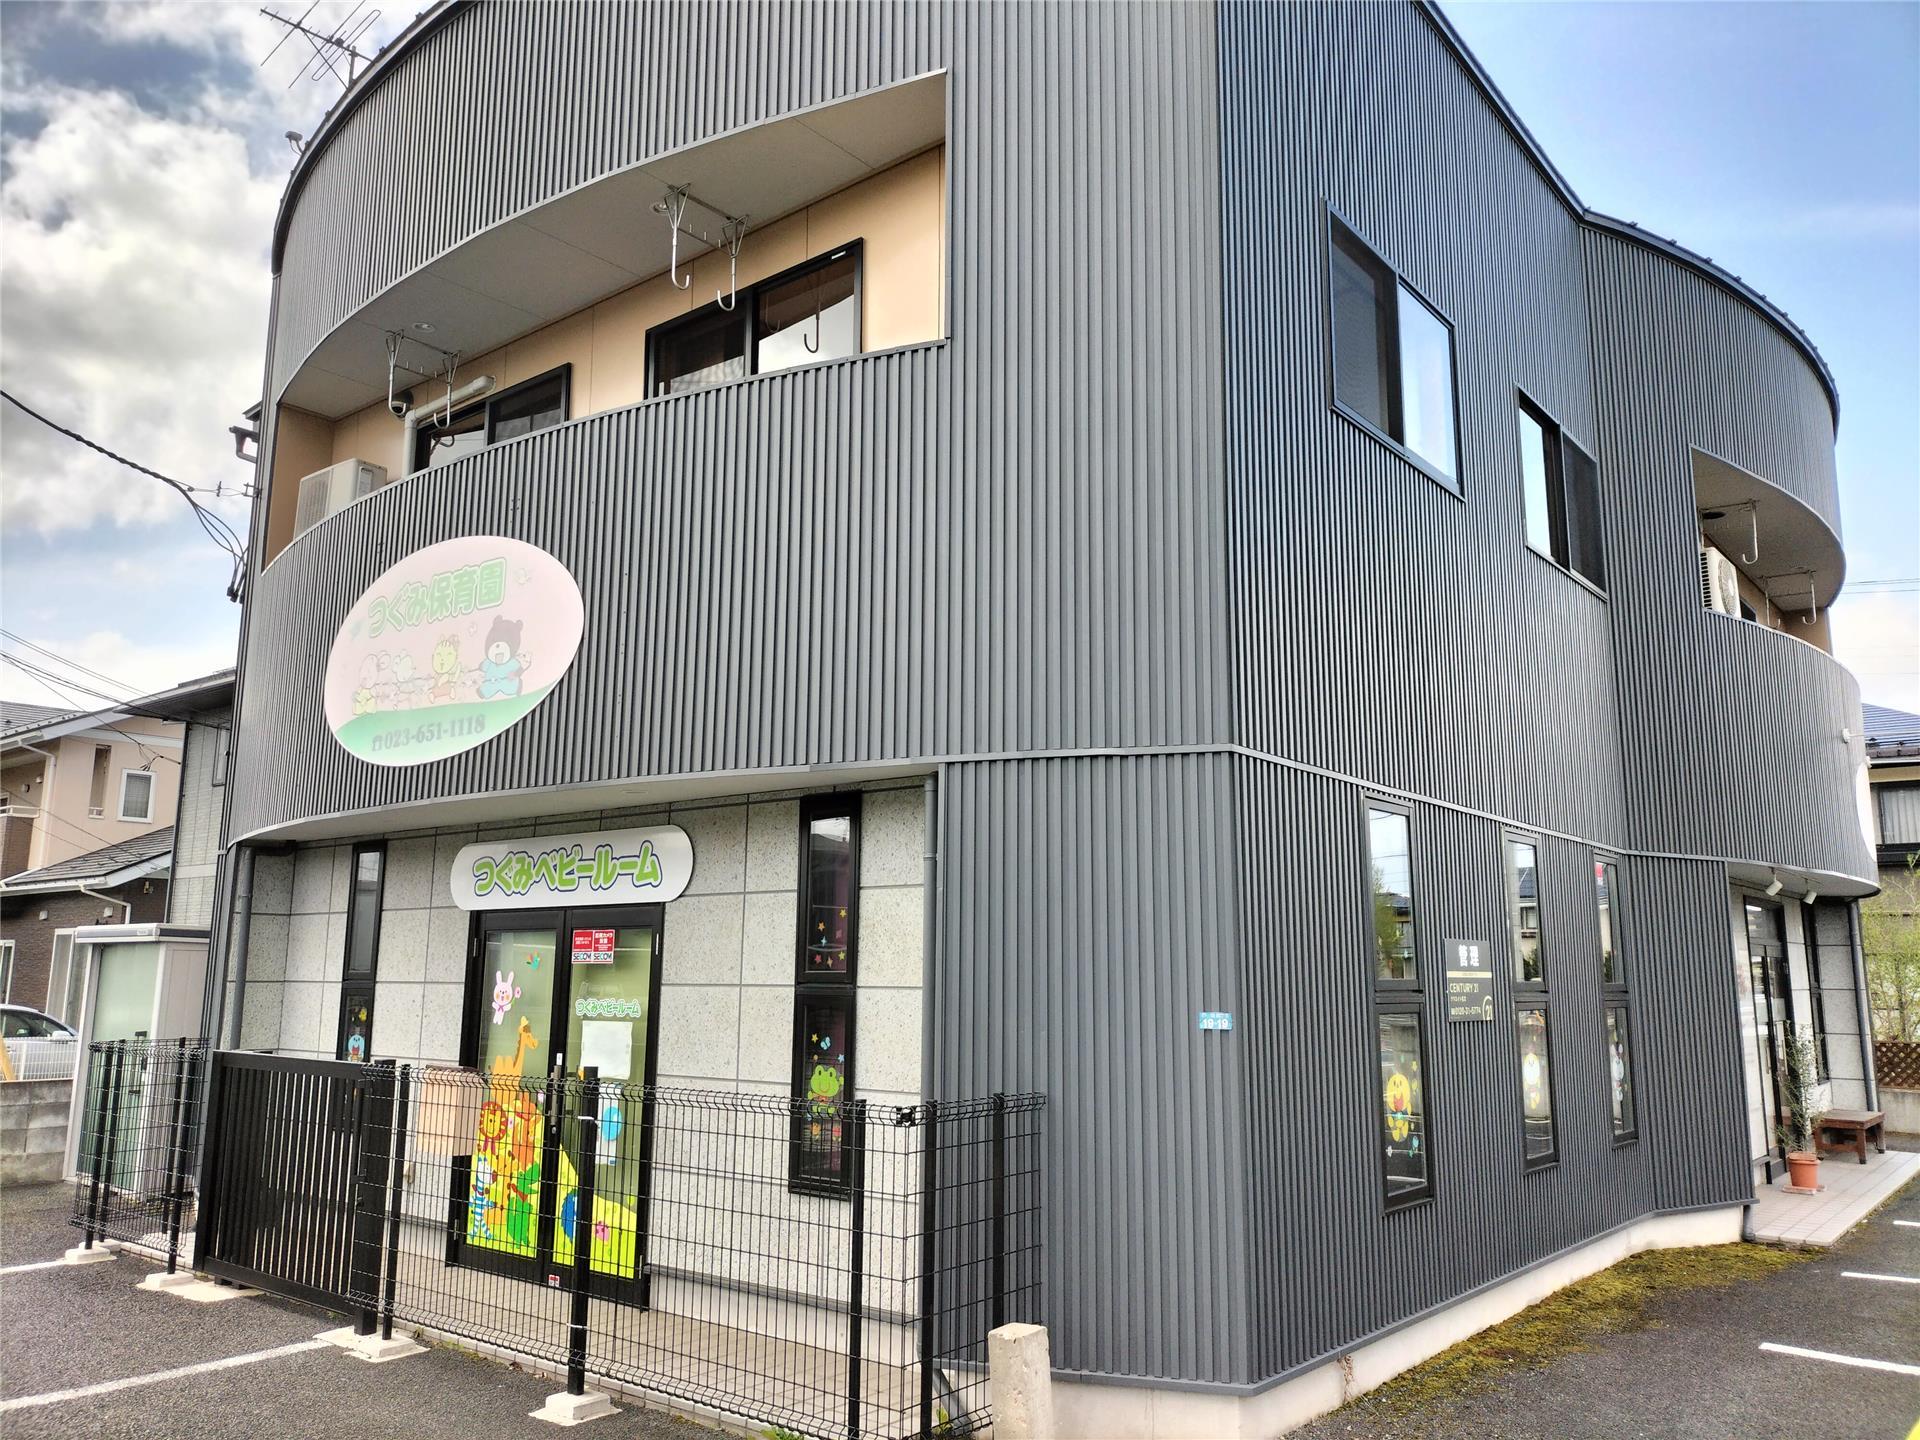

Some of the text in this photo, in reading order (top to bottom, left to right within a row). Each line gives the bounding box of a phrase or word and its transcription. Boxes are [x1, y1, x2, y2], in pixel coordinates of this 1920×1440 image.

[473, 840, 662, 896] つぐみベビールーム
[573, 952, 592, 961] SECOM
[593, 952, 612, 961] SECOM
[1450, 983, 1473, 993] CENTURY
